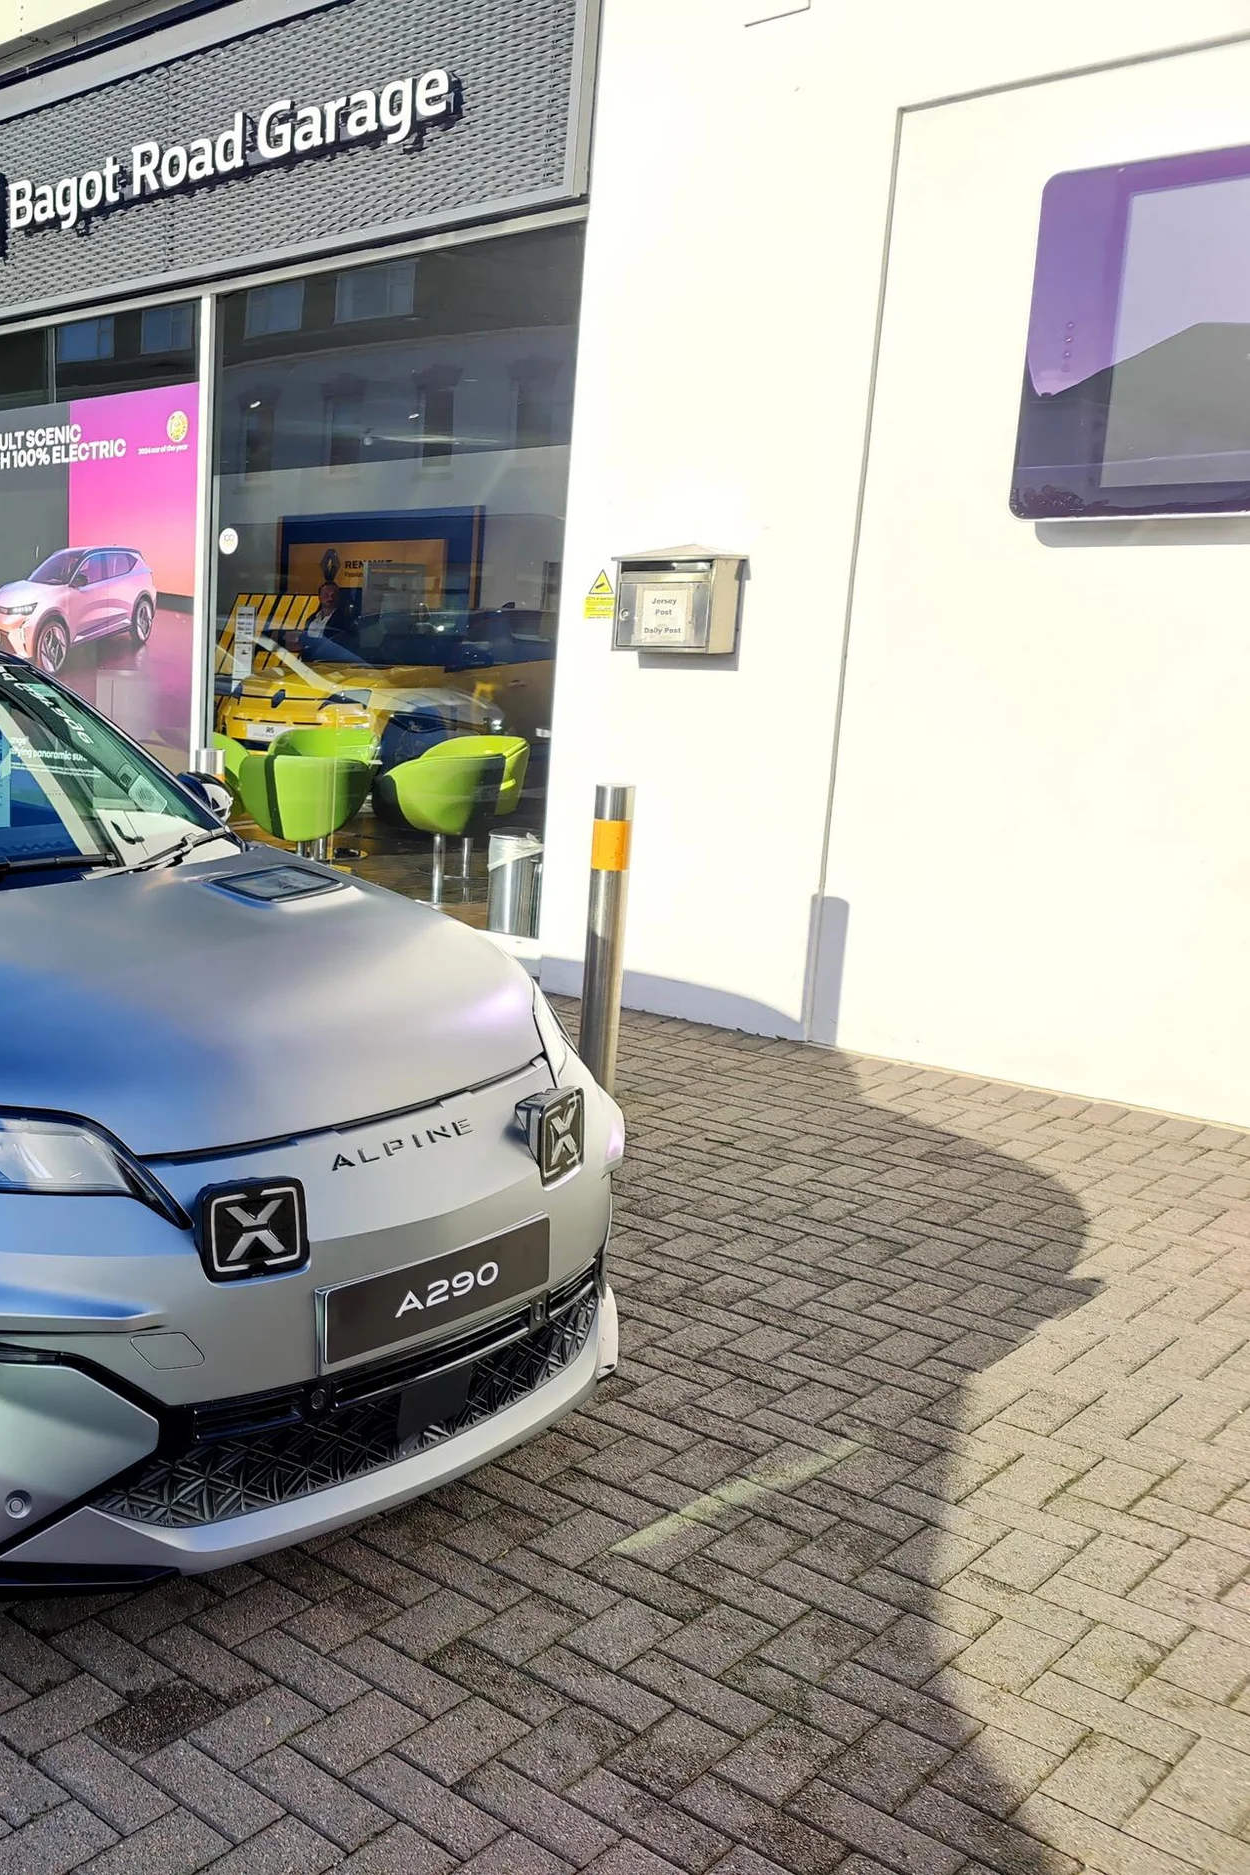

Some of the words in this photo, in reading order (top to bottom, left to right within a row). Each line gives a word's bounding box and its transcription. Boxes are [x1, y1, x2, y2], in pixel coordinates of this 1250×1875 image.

[9, 163, 121, 230] Bagot
[130, 111, 244, 197] Road
[256, 67, 450, 159] Garage
[25, 423, 82, 449] SCENIC
[12, 447, 50, 468] 100%
[52, 437, 127, 465] ELECTRIC
[651, 597, 677, 606] Jersey
[655, 608, 672, 616] Post
[643, 627, 663, 635] Daily
[331, 1117, 475, 1172] ALPINE
[394, 1260, 500, 1319] A290
